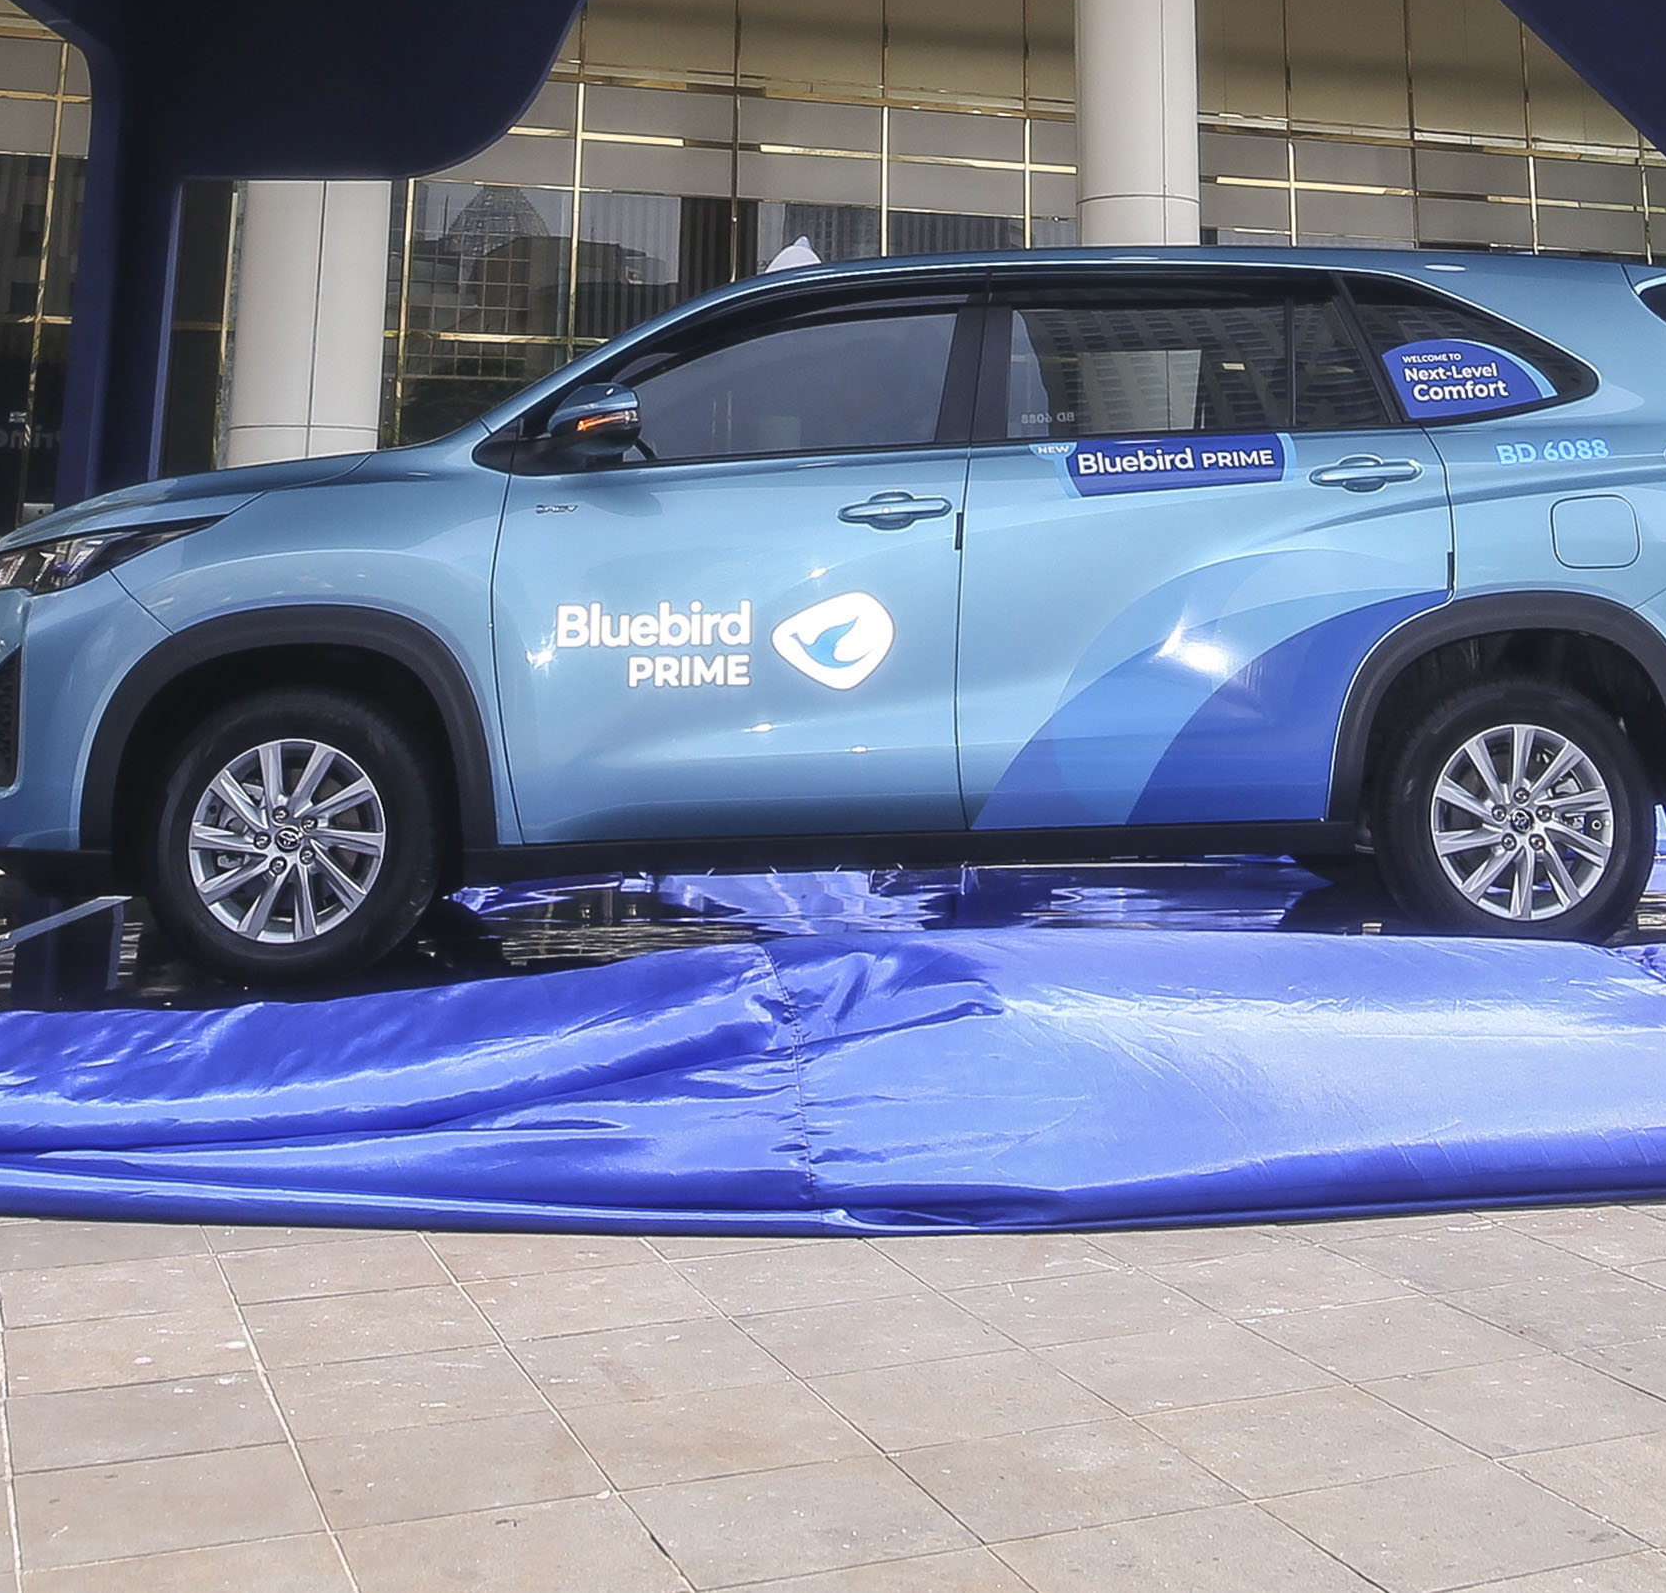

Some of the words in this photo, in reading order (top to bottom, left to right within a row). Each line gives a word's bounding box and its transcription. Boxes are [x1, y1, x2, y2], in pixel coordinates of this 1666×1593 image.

[1402, 353, 1448, 364] WELCOME
[1449, 353, 1462, 361] TO
[1404, 363, 1498, 382] Next-Level
[1413, 380, 1509, 401] Comfort
[1037, 445, 1070, 454] NEW
[1078, 447, 1194, 474] Bluebird
[1202, 450, 1275, 468] PRIME
[1496, 443, 1536, 465] BD
[1543, 439, 1609, 462] 6088
[556, 600, 751, 648] Bluebird
[628, 654, 751, 687] PRIME
